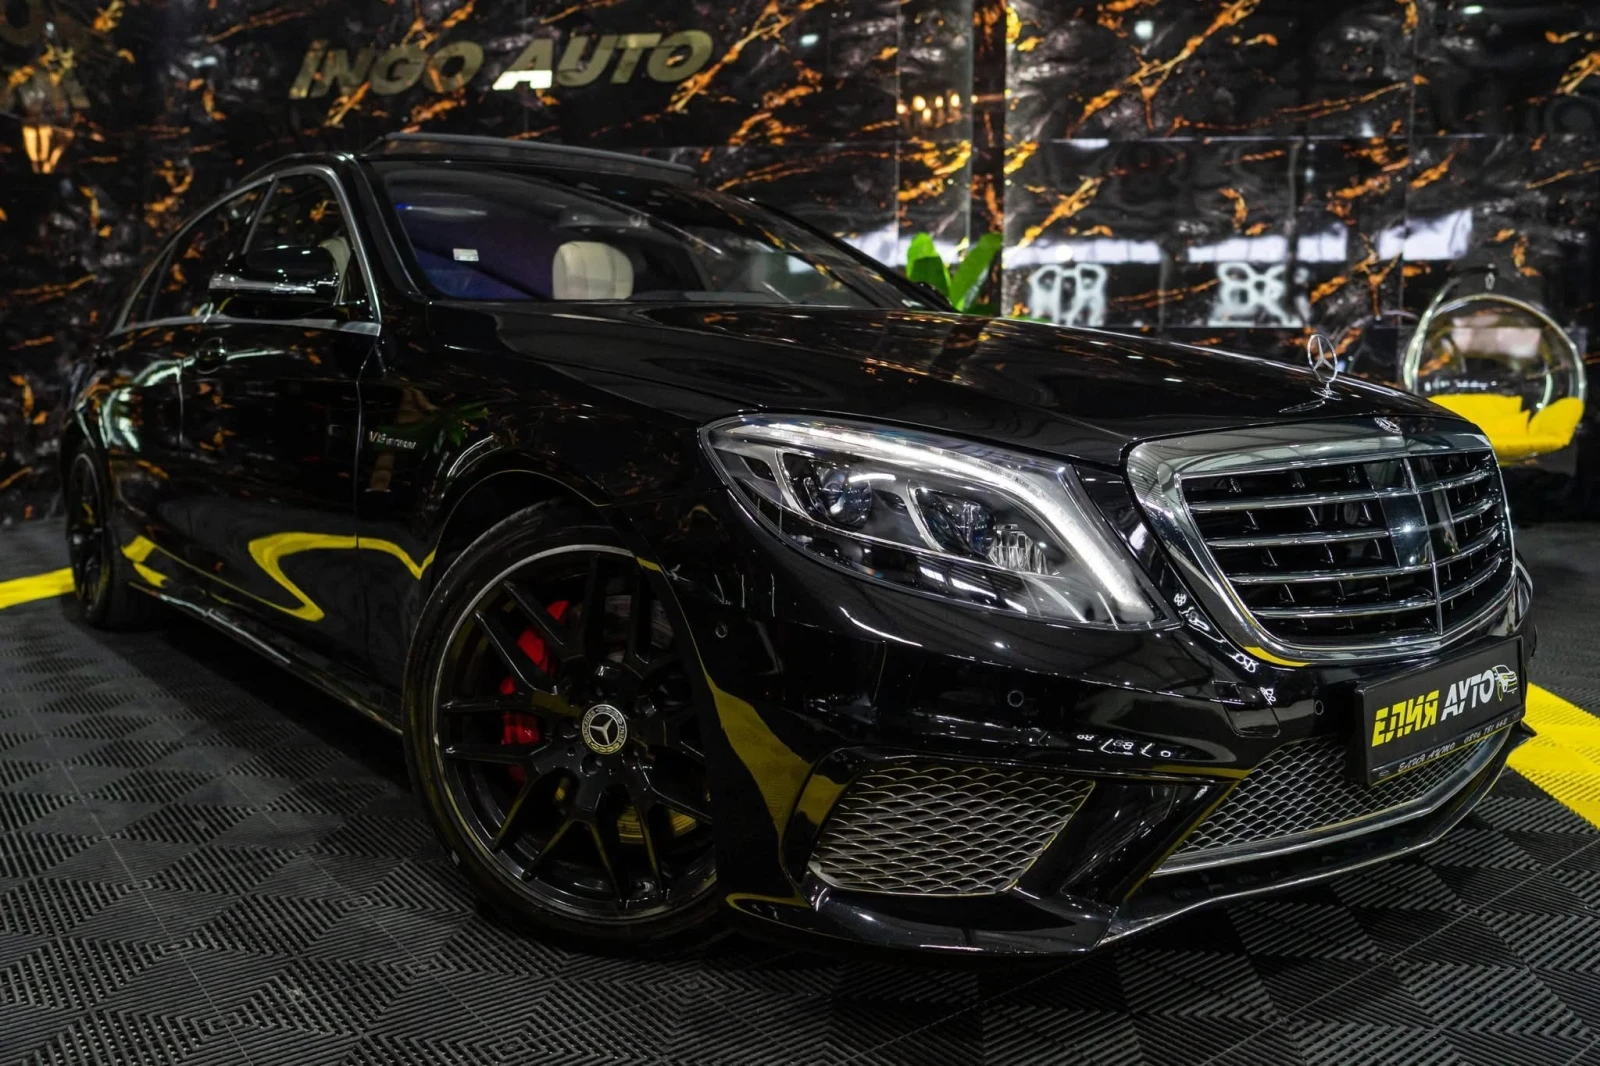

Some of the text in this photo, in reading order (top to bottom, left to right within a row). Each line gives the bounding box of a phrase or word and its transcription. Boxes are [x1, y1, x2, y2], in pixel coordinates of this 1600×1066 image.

[492, 30, 713, 90] AUTO
[1371, 669, 1495, 747] ЕЛИЯ АУТО
